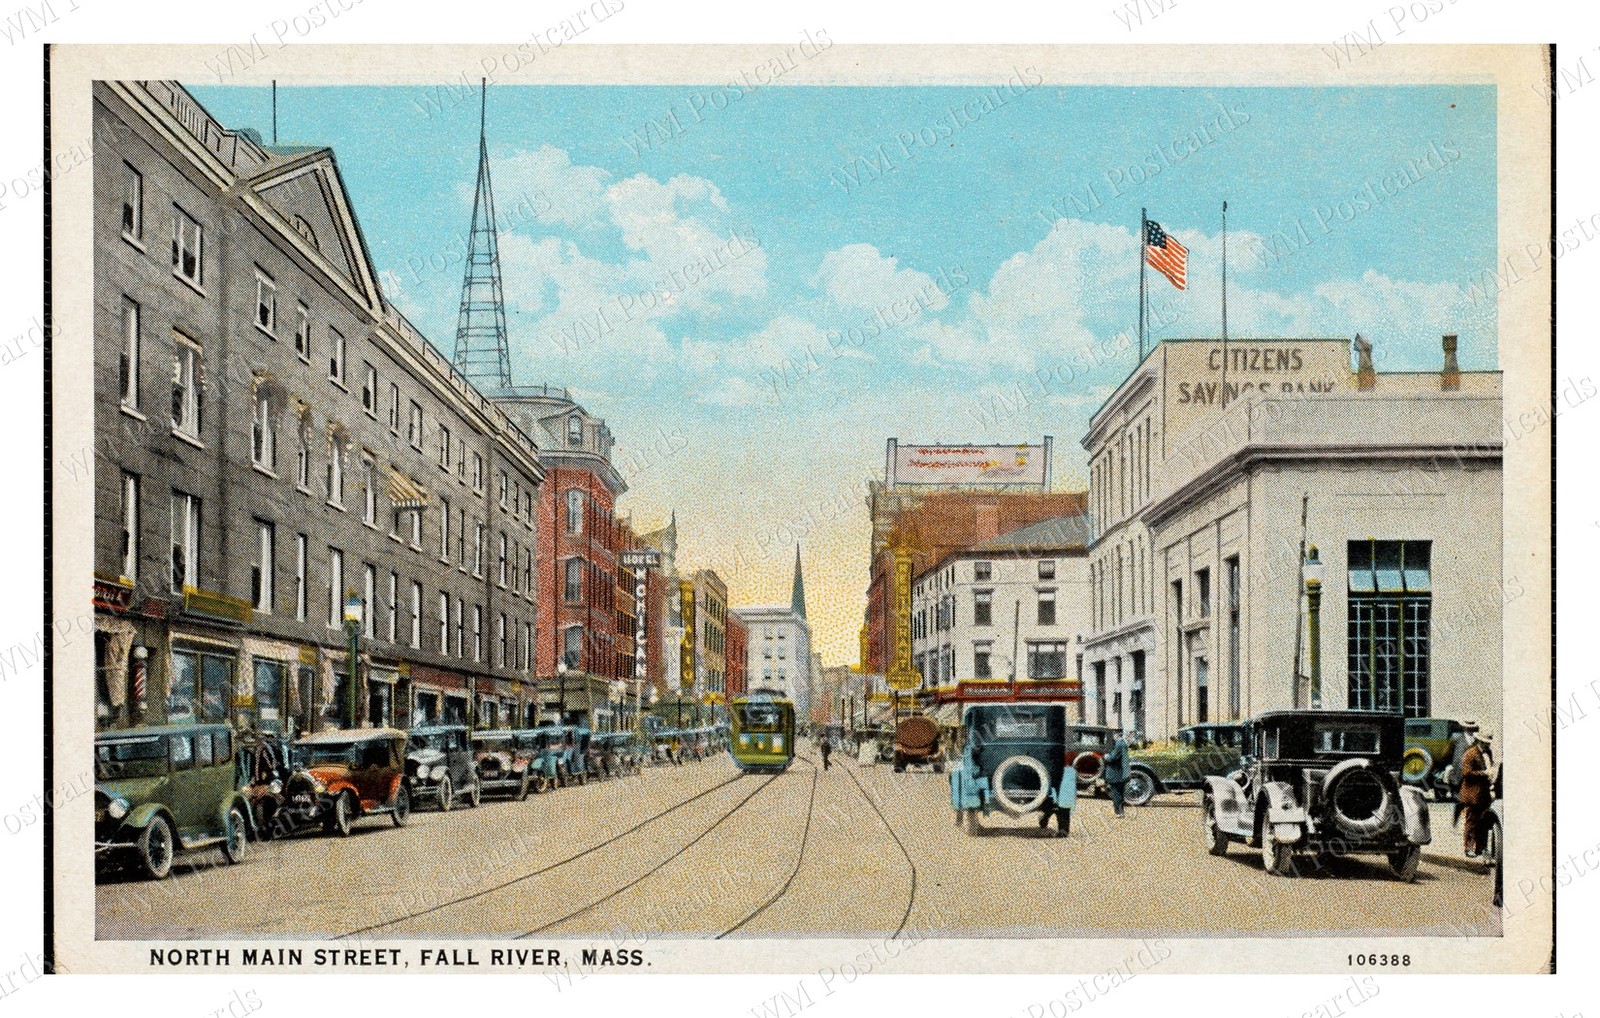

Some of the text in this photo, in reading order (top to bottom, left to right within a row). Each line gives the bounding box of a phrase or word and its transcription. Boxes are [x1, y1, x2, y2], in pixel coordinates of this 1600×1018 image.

[1208, 348, 1303, 371] CITIZENS
[622, 554, 659, 565] HOTEL
[635, 567, 647, 677] MOHICAN
